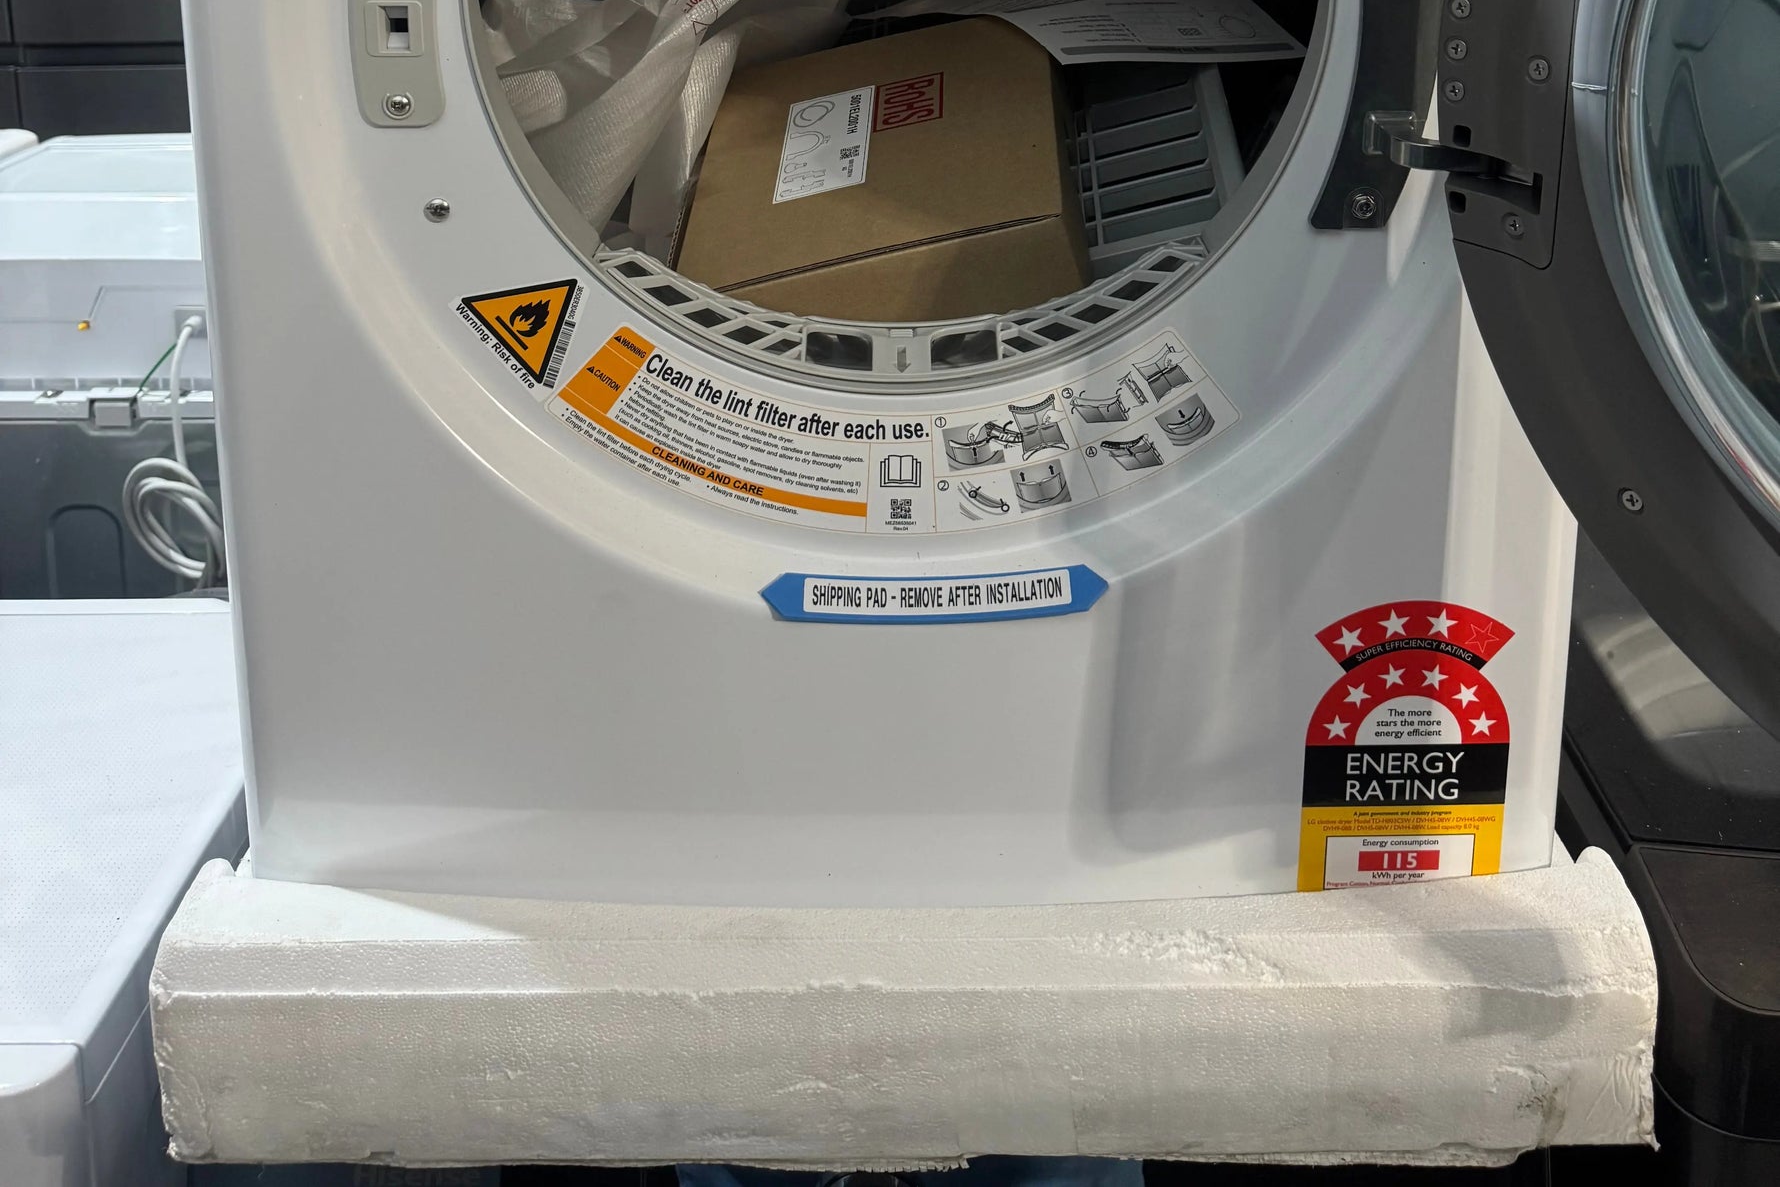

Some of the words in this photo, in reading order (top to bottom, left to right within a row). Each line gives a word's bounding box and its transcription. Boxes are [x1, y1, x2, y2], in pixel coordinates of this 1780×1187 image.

[620, 338, 647, 359] WARNING
[492, 342, 511, 364] Risk
[510, 364, 523, 376] of
[519, 371, 535, 390] fire
[593, 369, 621, 392] CAUTION
[646, 353, 693, 392] Clean
[694, 378, 722, 405] the
[722, 389, 753, 417] lint
[754, 400, 796, 429] filter
[798, 412, 840, 437] after
[844, 419, 886, 440] each
[892, 422, 930, 440] use.
[642, 377, 650, 385] Do
[651, 381, 660, 390] not
[660, 386, 673, 399] allow
[674, 393, 696, 408] children
[703, 409, 714, 419] pets
[722, 417, 734, 427] play
[750, 427, 767, 437] inside
[768, 432, 777, 440] the
[565, 417, 584, 433] Empty
[584, 429, 593, 439] the
[593, 436, 610, 450] water
[610, 447, 637, 465] container
[637, 462, 652, 473] after
[652, 470, 667, 482] each
[668, 478, 681, 487] use.
[570, 409, 586, 425] Clean
[587, 421, 597, 431] the
[596, 427, 607, 438] lint
[607, 433, 620, 446] filter
[619, 441, 639, 457] before
[639, 454, 654, 466] each
[655, 461, 674, 475] drying
[674, 471, 692, 483] cycle.
[651, 446, 706, 476] CLEANING
[707, 471, 731, 486] AND
[732, 479, 764, 496] CARE
[710, 485, 733, 497] Always
[734, 494, 749, 503] read
[750, 498, 760, 506] the
[761, 501, 798, 515] instructions.
[812, 583, 862, 608] SHIPPING
[866, 587, 888, 609] PAD
[900, 587, 943, 609] REMOVE
[948, 584, 982, 607] AFTER
[986, 576, 1063, 604] INSTALLATION
[1356, 642, 1384, 662] SUPER
[1386, 639, 1438, 651] EFFICIENCY
[1439, 643, 1472, 662] RATING
[1376, 719, 1398, 727] stars
[1400, 718, 1415, 727] the
[1417, 719, 1442, 727] more
[1388, 708, 1406, 717] The
[1374, 729, 1405, 739] energy
[1407, 728, 1442, 737] efficient
[1346, 752, 1464, 775] ENERGY
[1345, 778, 1459, 801] RATING
[1362, 838, 1388, 848] Energy
[1390, 838, 1439, 847] consumption
[1382, 852, 1418, 869] 115
[1372, 871, 1391, 879] kWh
[1393, 873, 1405, 881] per
[1407, 872, 1425, 880] year
